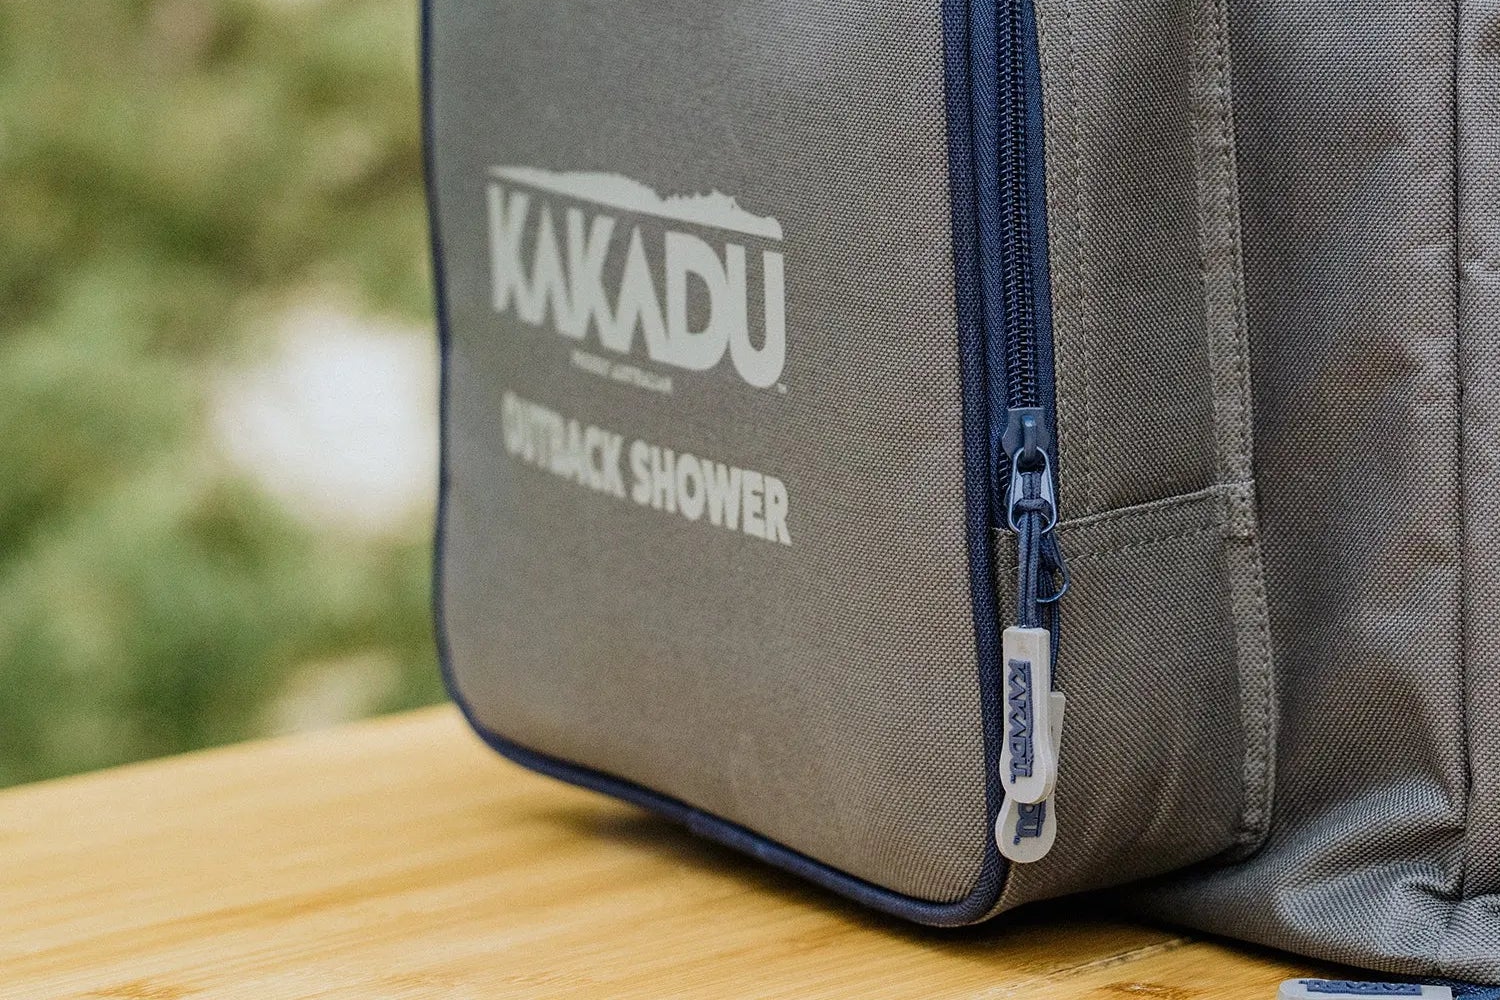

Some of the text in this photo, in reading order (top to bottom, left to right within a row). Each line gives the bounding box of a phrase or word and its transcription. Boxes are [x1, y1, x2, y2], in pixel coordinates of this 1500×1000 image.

[489, 184, 787, 391] KAKADU
[628, 438, 792, 547] SHOWER
[1008, 658, 1034, 777] KAKADU
